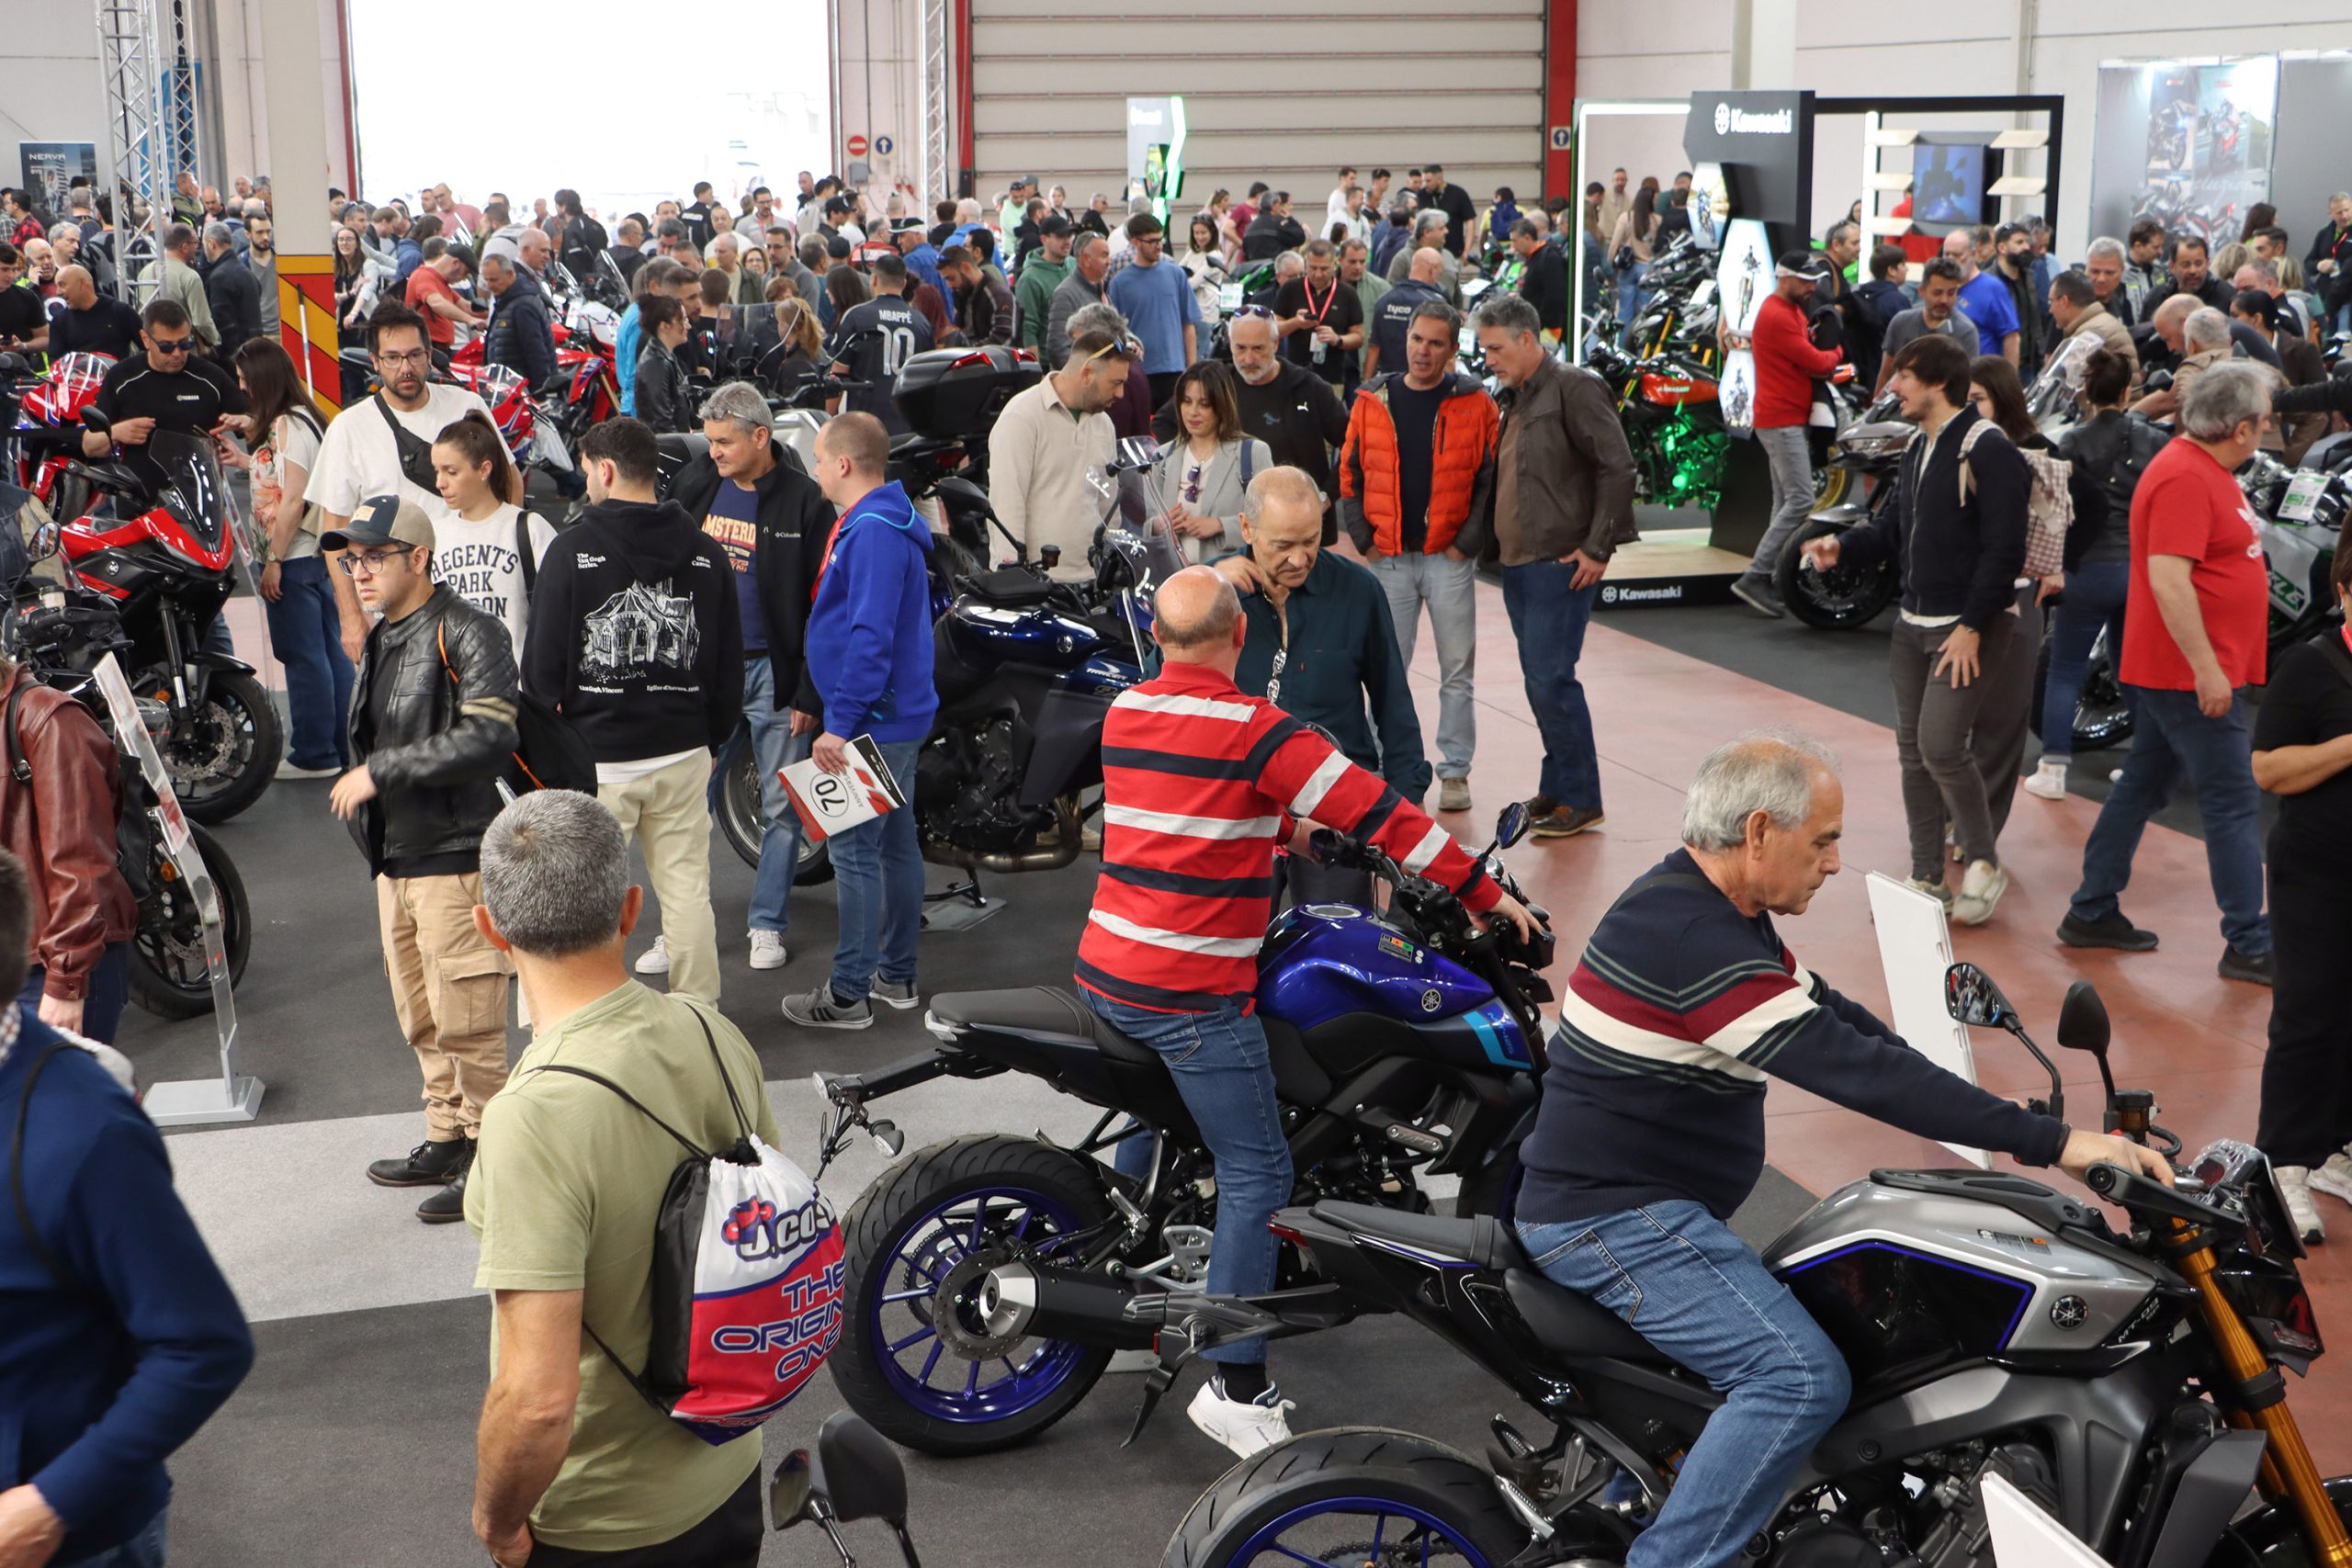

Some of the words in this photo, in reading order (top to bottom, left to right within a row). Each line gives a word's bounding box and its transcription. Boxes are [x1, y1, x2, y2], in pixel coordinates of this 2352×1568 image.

[1730, 107, 1792, 133] Kawasaki
[878, 309, 912, 324] MBAPPÉ
[876, 323, 915, 377] 10
[447, 570, 493, 594] PARK
[1619, 586, 1682, 600] Kawasaki
[815, 779, 845, 811] 70
[781, 1258, 846, 1312] THE
[2118, 1297, 2159, 1344] MT-09
[775, 1321, 840, 1382] ONE
